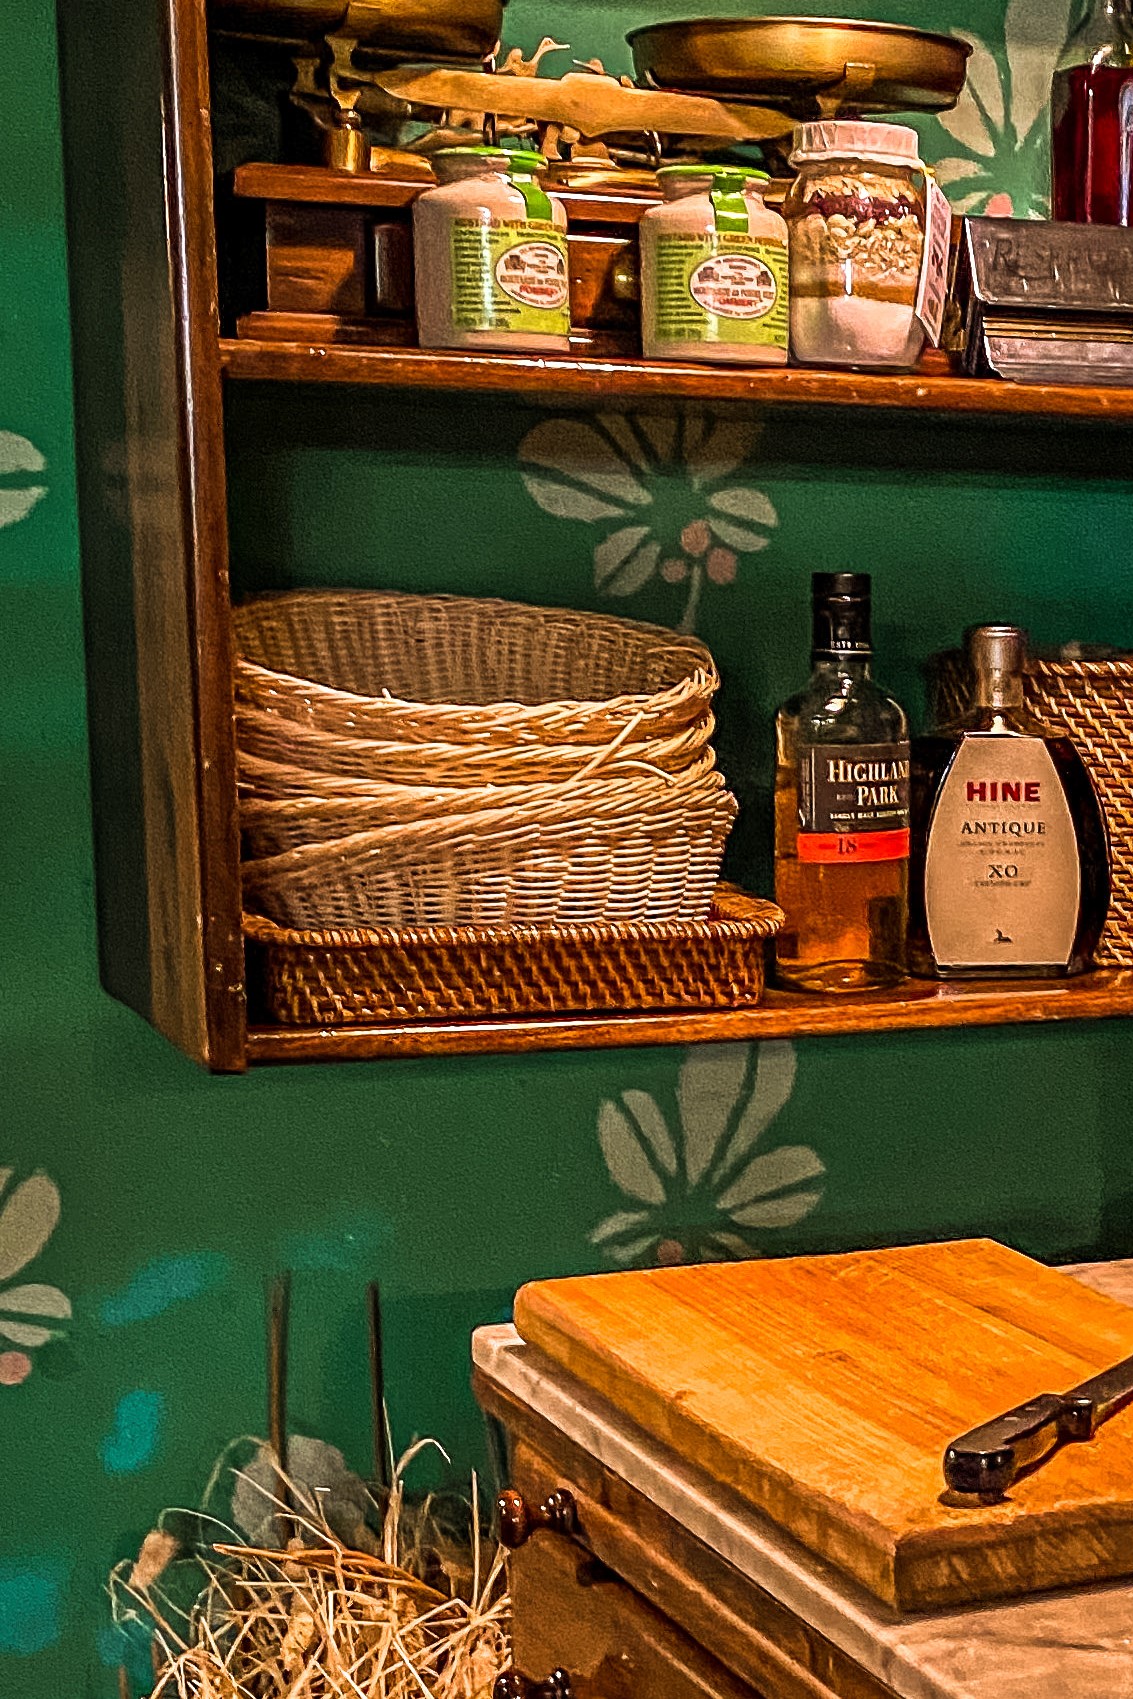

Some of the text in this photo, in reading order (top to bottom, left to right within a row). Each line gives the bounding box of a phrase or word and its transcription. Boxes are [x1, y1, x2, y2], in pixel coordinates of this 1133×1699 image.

[856, 785, 900, 806] PARK
[966, 781, 1041, 802] HINE
[961, 821, 1046, 837] ANTIQUE
[837, 837, 859, 855] 18
[988, 864, 1018, 878] XO
